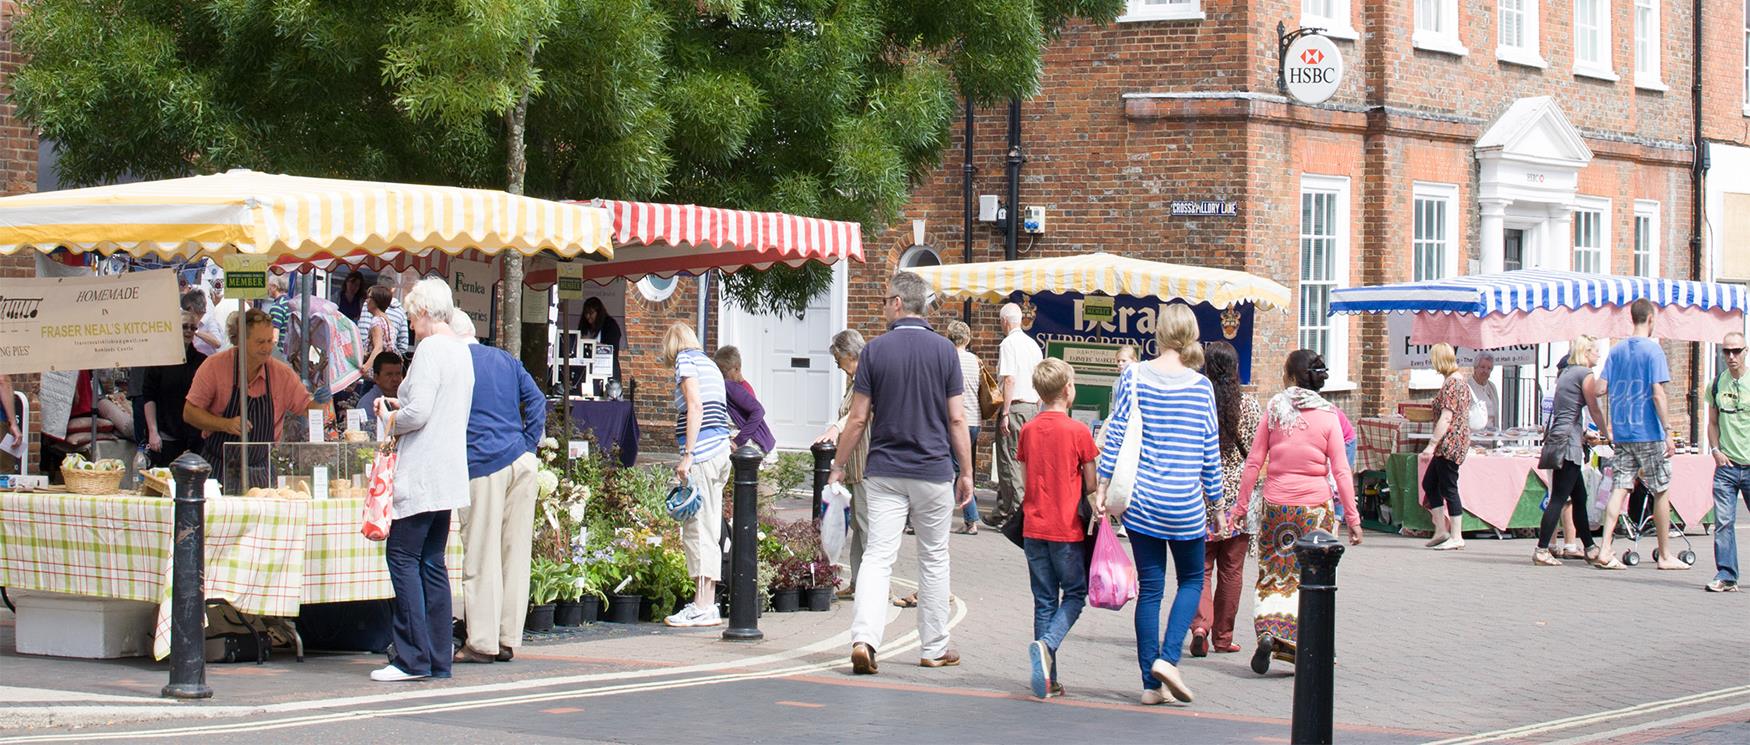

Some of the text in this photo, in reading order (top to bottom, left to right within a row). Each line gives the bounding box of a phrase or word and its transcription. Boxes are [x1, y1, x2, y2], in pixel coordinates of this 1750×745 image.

[1290, 67, 1335, 84] HSBC
[228, 277, 263, 287] MEMBER
[455, 271, 486, 295] Fernlea
[76, 286, 139, 303] HOMEMADE
[41, 320, 173, 338] FRASER NEAL'S KITCHEN
